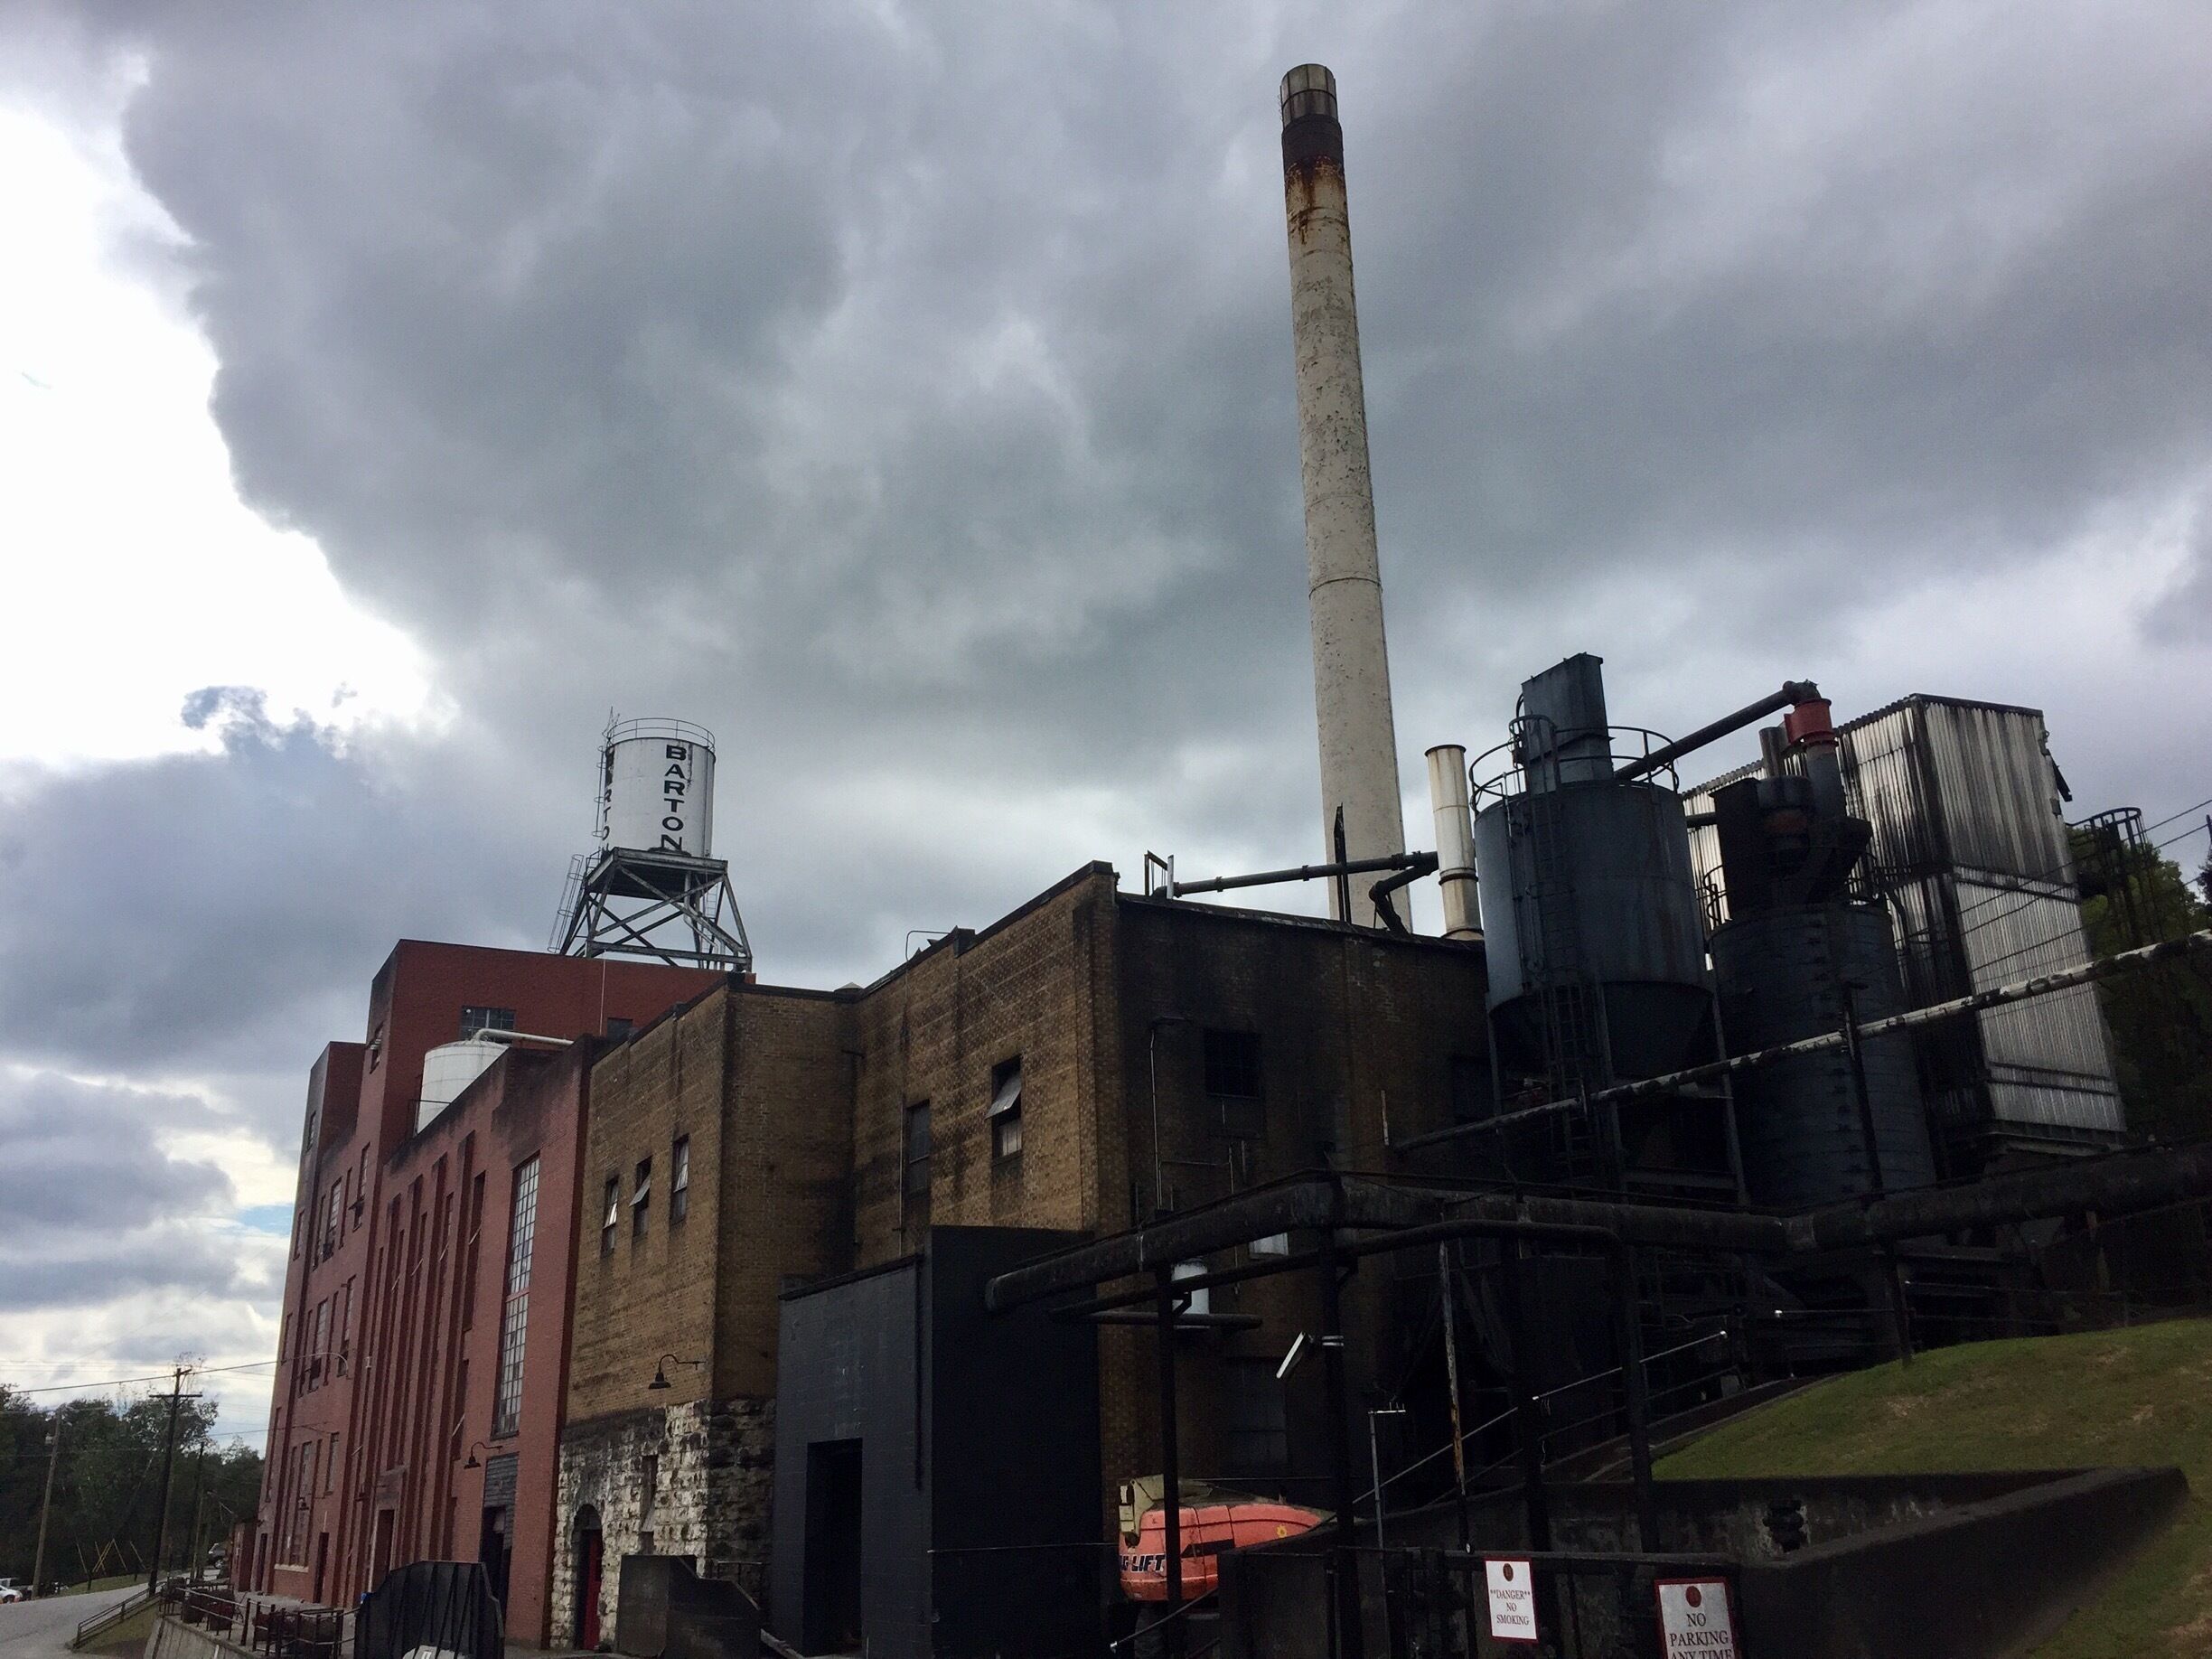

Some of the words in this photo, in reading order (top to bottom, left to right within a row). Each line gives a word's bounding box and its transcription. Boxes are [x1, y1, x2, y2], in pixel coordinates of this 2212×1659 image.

[661, 745, 687, 851] BARTON
[1131, 1554, 1166, 1572] LIFT
[1505, 1602, 1517, 1612] NO
[1496, 1614, 1530, 1626] SMOKING
[1686, 1612, 1707, 1627] NO
[1670, 1630, 1729, 1647] PARKING
